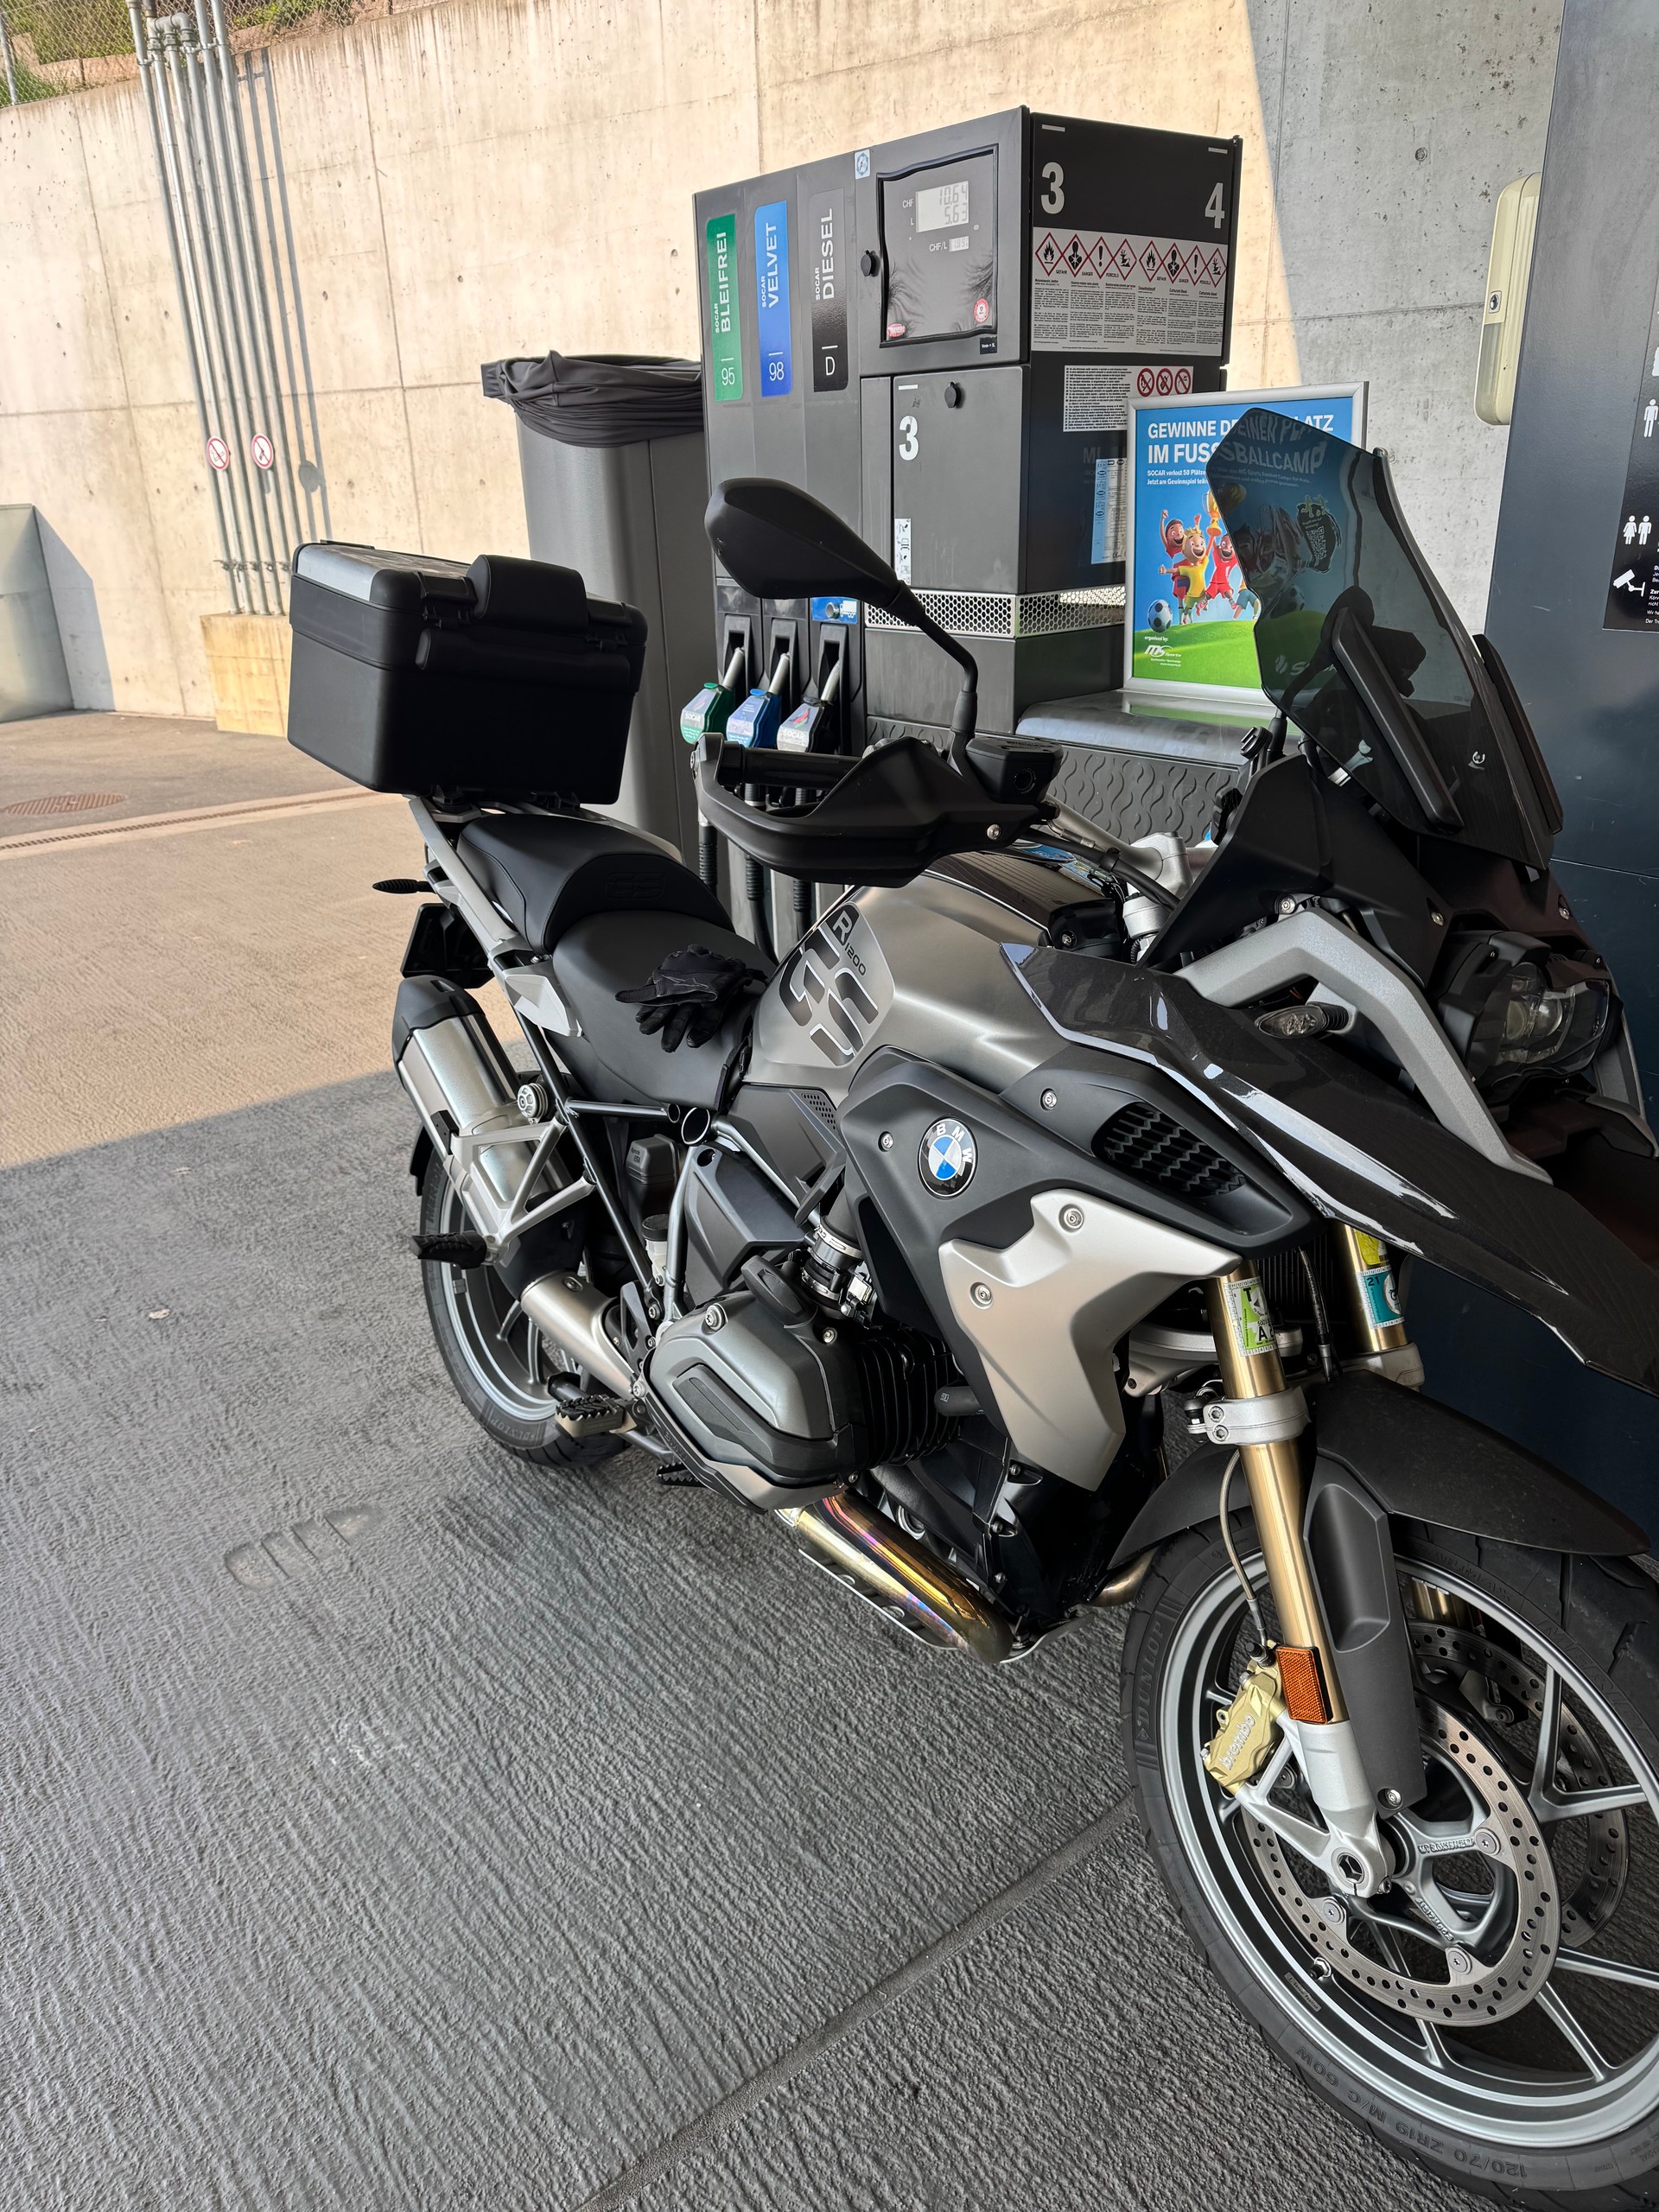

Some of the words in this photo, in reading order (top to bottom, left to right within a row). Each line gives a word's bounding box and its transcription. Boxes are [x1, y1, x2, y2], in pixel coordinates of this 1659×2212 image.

[902, 199, 914, 208] CHF
[939, 184, 969, 206] 10.64
[1040, 162, 1065, 214] 3
[910, 216, 915, 226] L
[944, 203, 969, 226] 5.63
[1205, 182, 1225, 229] 4
[821, 208, 835, 300] DIESEL
[929, 242, 948, 252] CHF/L
[766, 222, 779, 308] VELVET
[716, 232, 731, 333] BLEIFREI
[721, 367, 735, 386] 95
[769, 361, 785, 382] 98
[825, 356, 836, 376] D
[899, 415, 919, 461] 3
[1147, 420, 1217, 439] GEWINNE
[1147, 444, 1169, 464] IM
[832, 910, 853, 941] R
[844, 943, 867, 976] 1200
[936, 1123, 974, 1163] BMW
[1243, 1287, 1252, 1302] T
[1366, 1275, 1381, 1287] 21
[1258, 1326, 1268, 1341] A
[1136, 1620, 1165, 1726] DUNLOP
[1218, 1713, 1256, 1770] brembo
[1296, 2045, 1339, 2088] 60W
[1347, 2088, 1387, 2125] M/C
[1395, 2121, 1445, 2155] ZR19
[1453, 2149, 1528, 2179] 120/70
